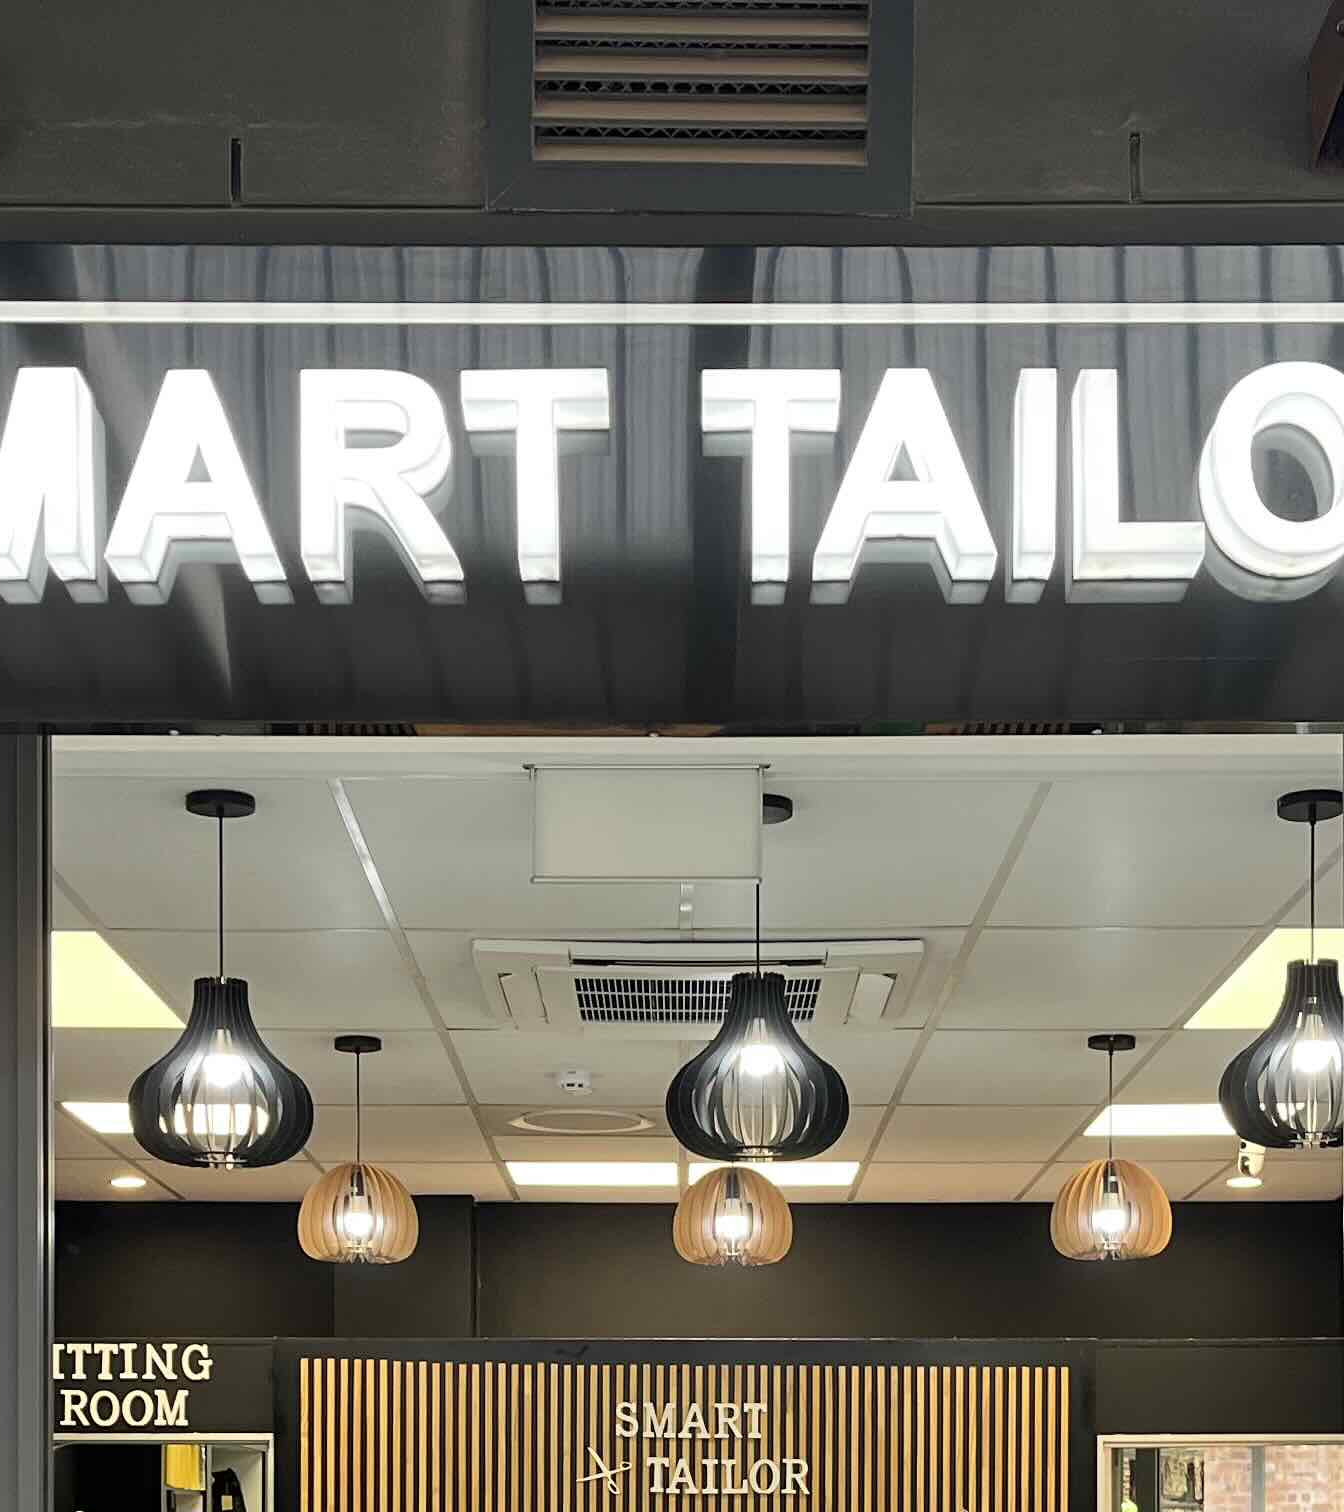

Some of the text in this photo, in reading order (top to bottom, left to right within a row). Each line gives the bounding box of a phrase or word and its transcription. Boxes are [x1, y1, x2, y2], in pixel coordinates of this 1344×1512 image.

[52, 1343, 213, 1380] ITTING
[60, 1389, 189, 1426] ROOM
[616, 1401, 767, 1439] SMART
[647, 1456, 810, 1495] TAILOR
